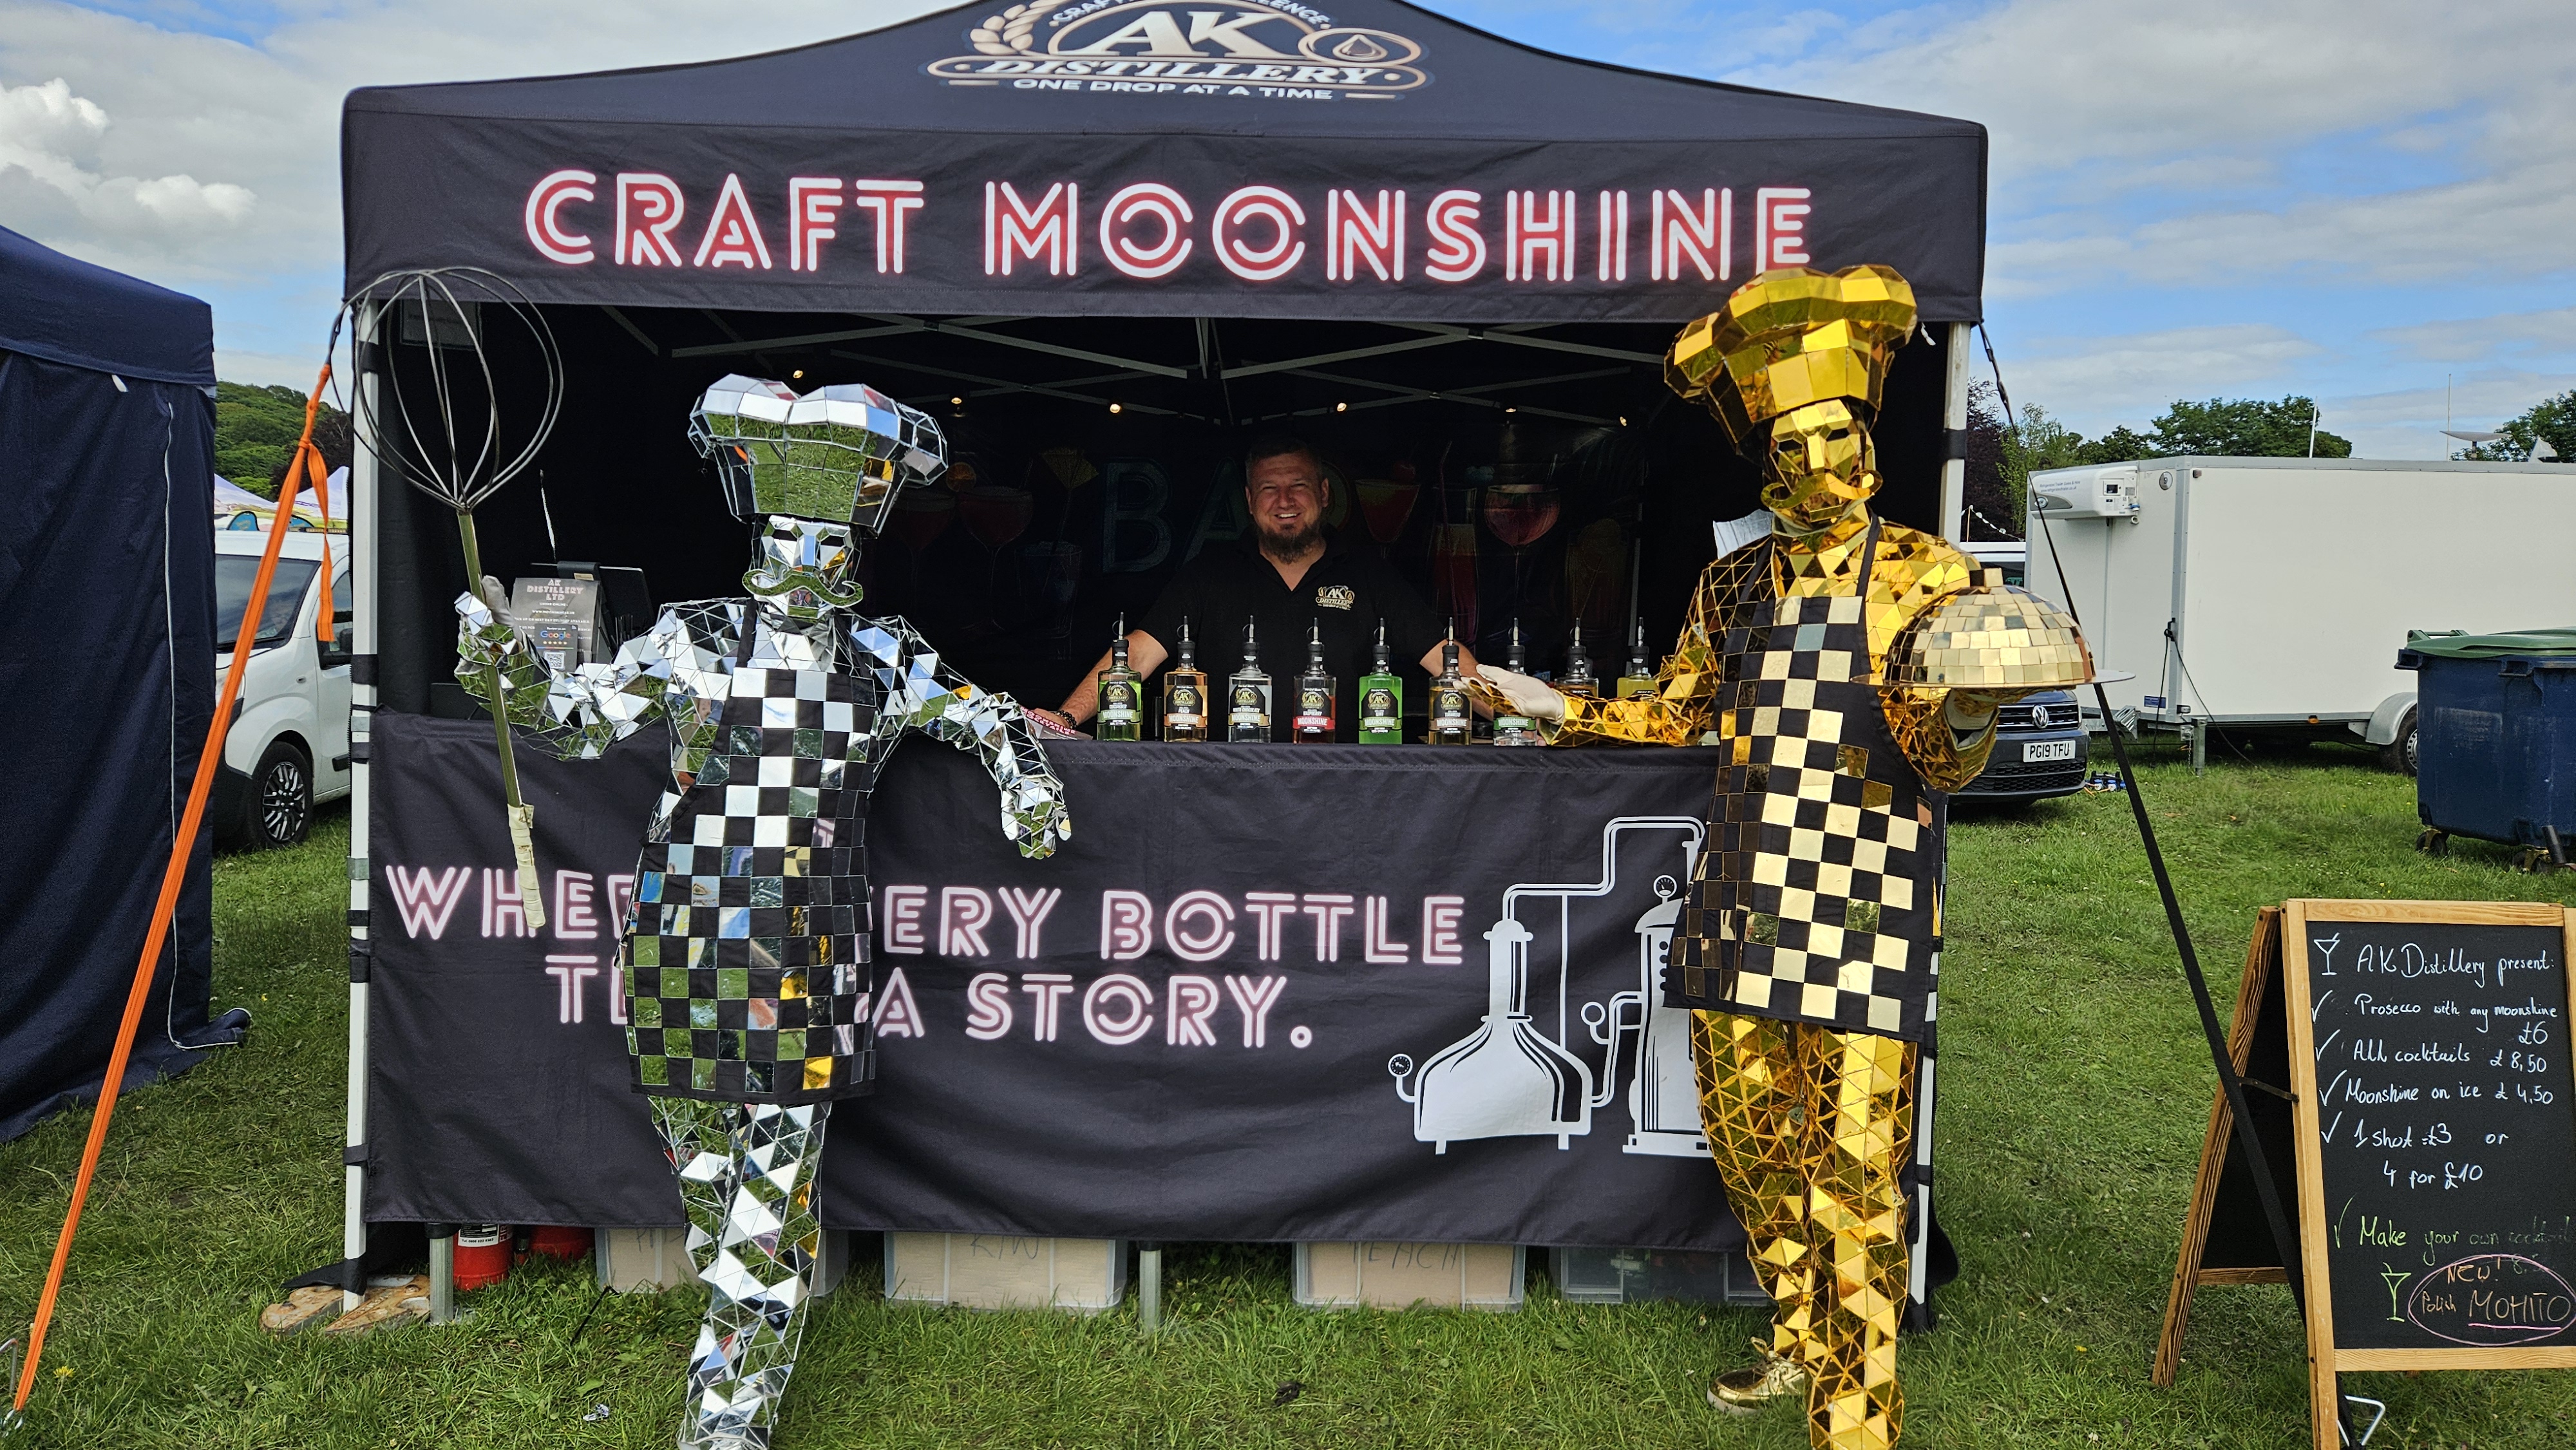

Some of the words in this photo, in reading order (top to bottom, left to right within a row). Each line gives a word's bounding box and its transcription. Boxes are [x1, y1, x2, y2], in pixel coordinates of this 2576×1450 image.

[1057, 11, 1307, 58] AK
[975, 61, 1384, 84] DISTILLERY
[1013, 79, 1083, 91] ONE
[1090, 80, 1177, 93] DROP
[1182, 84, 1221, 95] AT
[1227, 86, 1251, 96] A
[1258, 87, 1333, 100] TIME
[525, 170, 924, 274] CRAFT
[985, 181, 1812, 281] MOONSHINE
[527, 585, 584, 594] DISTILLERY
[1327, 588, 1346, 599] AK
[540, 630, 571, 640] Google
[1103, 710, 1133, 719] MOONSHINE
[1169, 715, 1199, 723] MOONSHINE
[1231, 714, 1261, 722] MOONSHINE
[1297, 717, 1328, 726] MOONSHINE
[1364, 718, 1395, 726] MOONSHINE
[1436, 719, 1467, 727] MOONSHINE
[2029, 744, 2050, 759] PG19
[2052, 742, 2070, 758] TFU
[870, 886, 1061, 959] ERY
[1101, 890, 1465, 965] BOTTLE
[2400, 943, 2485, 988] Distillery
[965, 972, 1313, 1048] STORY.
[2354, 993, 2421, 1015] Prosecco
[2434, 1000, 2460, 1016] with
[2470, 1006, 2489, 1033] any
[2494, 997, 2558, 1017] moonshine
[2519, 1021, 2548, 1045] £6
[2353, 1039, 2387, 1062] All
[2394, 1042, 2470, 1063] cocktails
[2345, 1077, 2419, 1104] Moonshine
[2430, 1086, 2450, 1100] on
[2459, 1080, 2482, 1098] ice
[2354, 1118, 2368, 1148] 1
[2371, 1125, 2412, 1149] shot
[2485, 1132, 2510, 1145] or
[2383, 1160, 2397, 1187] 4
[2409, 1170, 2436, 1189] for
[2444, 1161, 2483, 1190] £10
[2359, 1216, 2407, 1247] Make
[2424, 1229, 2460, 1266] your
[2468, 1232, 2499, 1245] own
[2422, 1290, 2457, 1315] Polish
[2468, 1290, 2571, 1324] MOHITO
